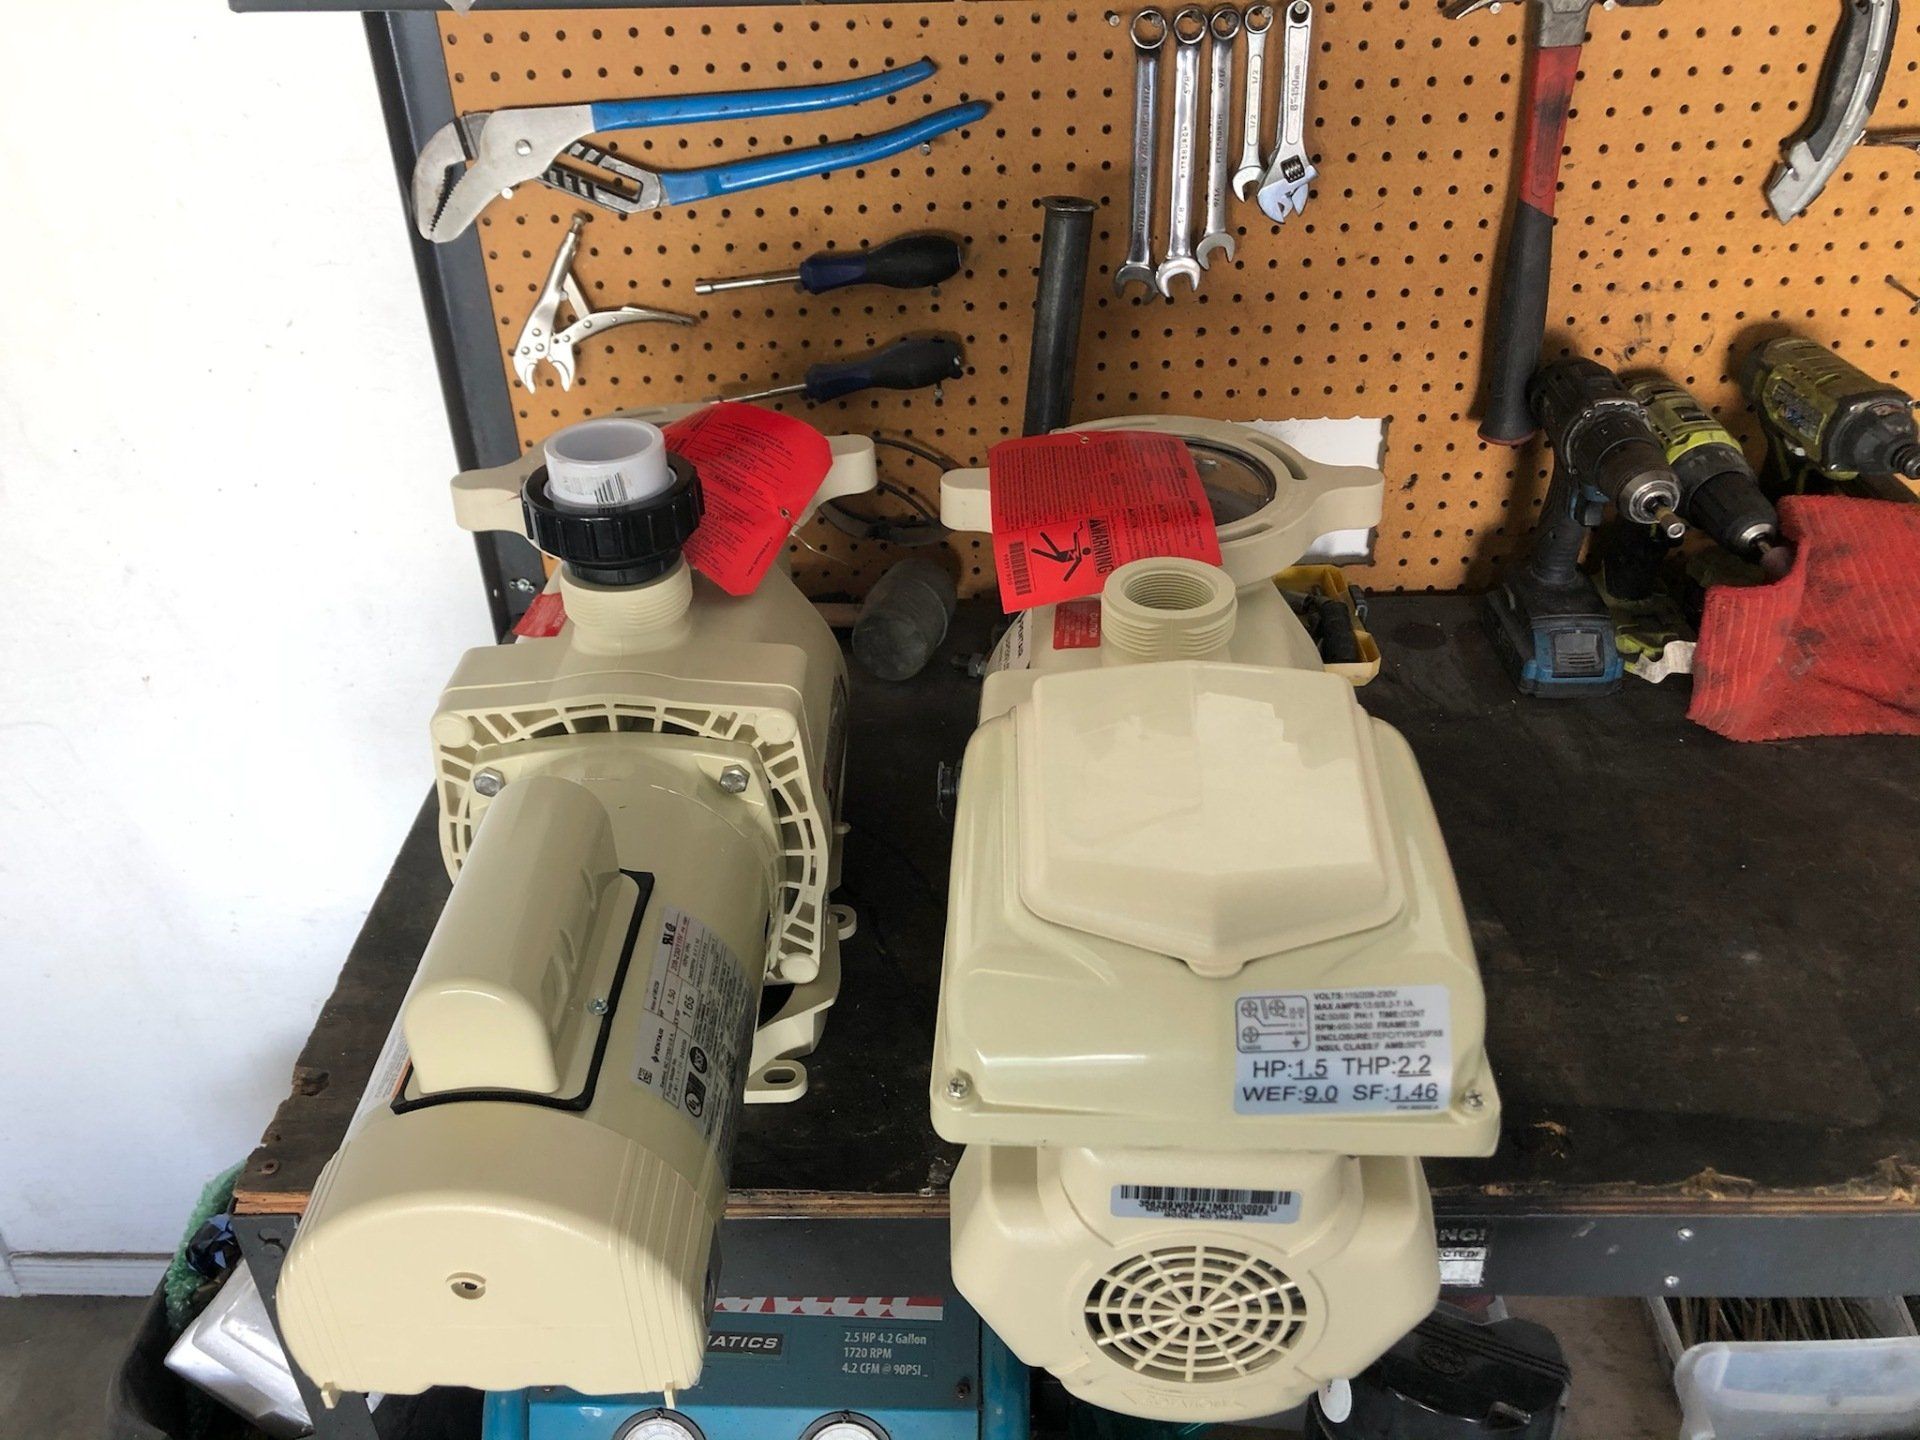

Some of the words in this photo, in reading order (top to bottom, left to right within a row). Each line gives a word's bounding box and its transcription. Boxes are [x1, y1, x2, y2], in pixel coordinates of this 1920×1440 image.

[1090, 519, 1115, 575] WARNING
[682, 995, 695, 1018] 1.65
[653, 1027, 664, 1055] PENTAIR
[1252, 1058, 1328, 1079] HP:1.5
[1341, 1055, 1432, 1077] THP:2.2
[1242, 1085, 1338, 1104] WEF:9.0
[1353, 1083, 1438, 1103] SF:1.46
[707, 1335, 779, 1349] ATICS
[844, 1331, 860, 1343] 2.5
[861, 1332, 877, 1344] HP
[877, 1332, 894, 1345] 4.2
[895, 1333, 927, 1345] Gallon
[844, 1346, 868, 1359] 1720
[869, 1347, 892, 1359] RPM
[842, 1362, 858, 1375] 4.2
[859, 1363, 881, 1375] CFM
[882, 1364, 892, 1374] @
[893, 1364, 922, 1376] 90PSI
